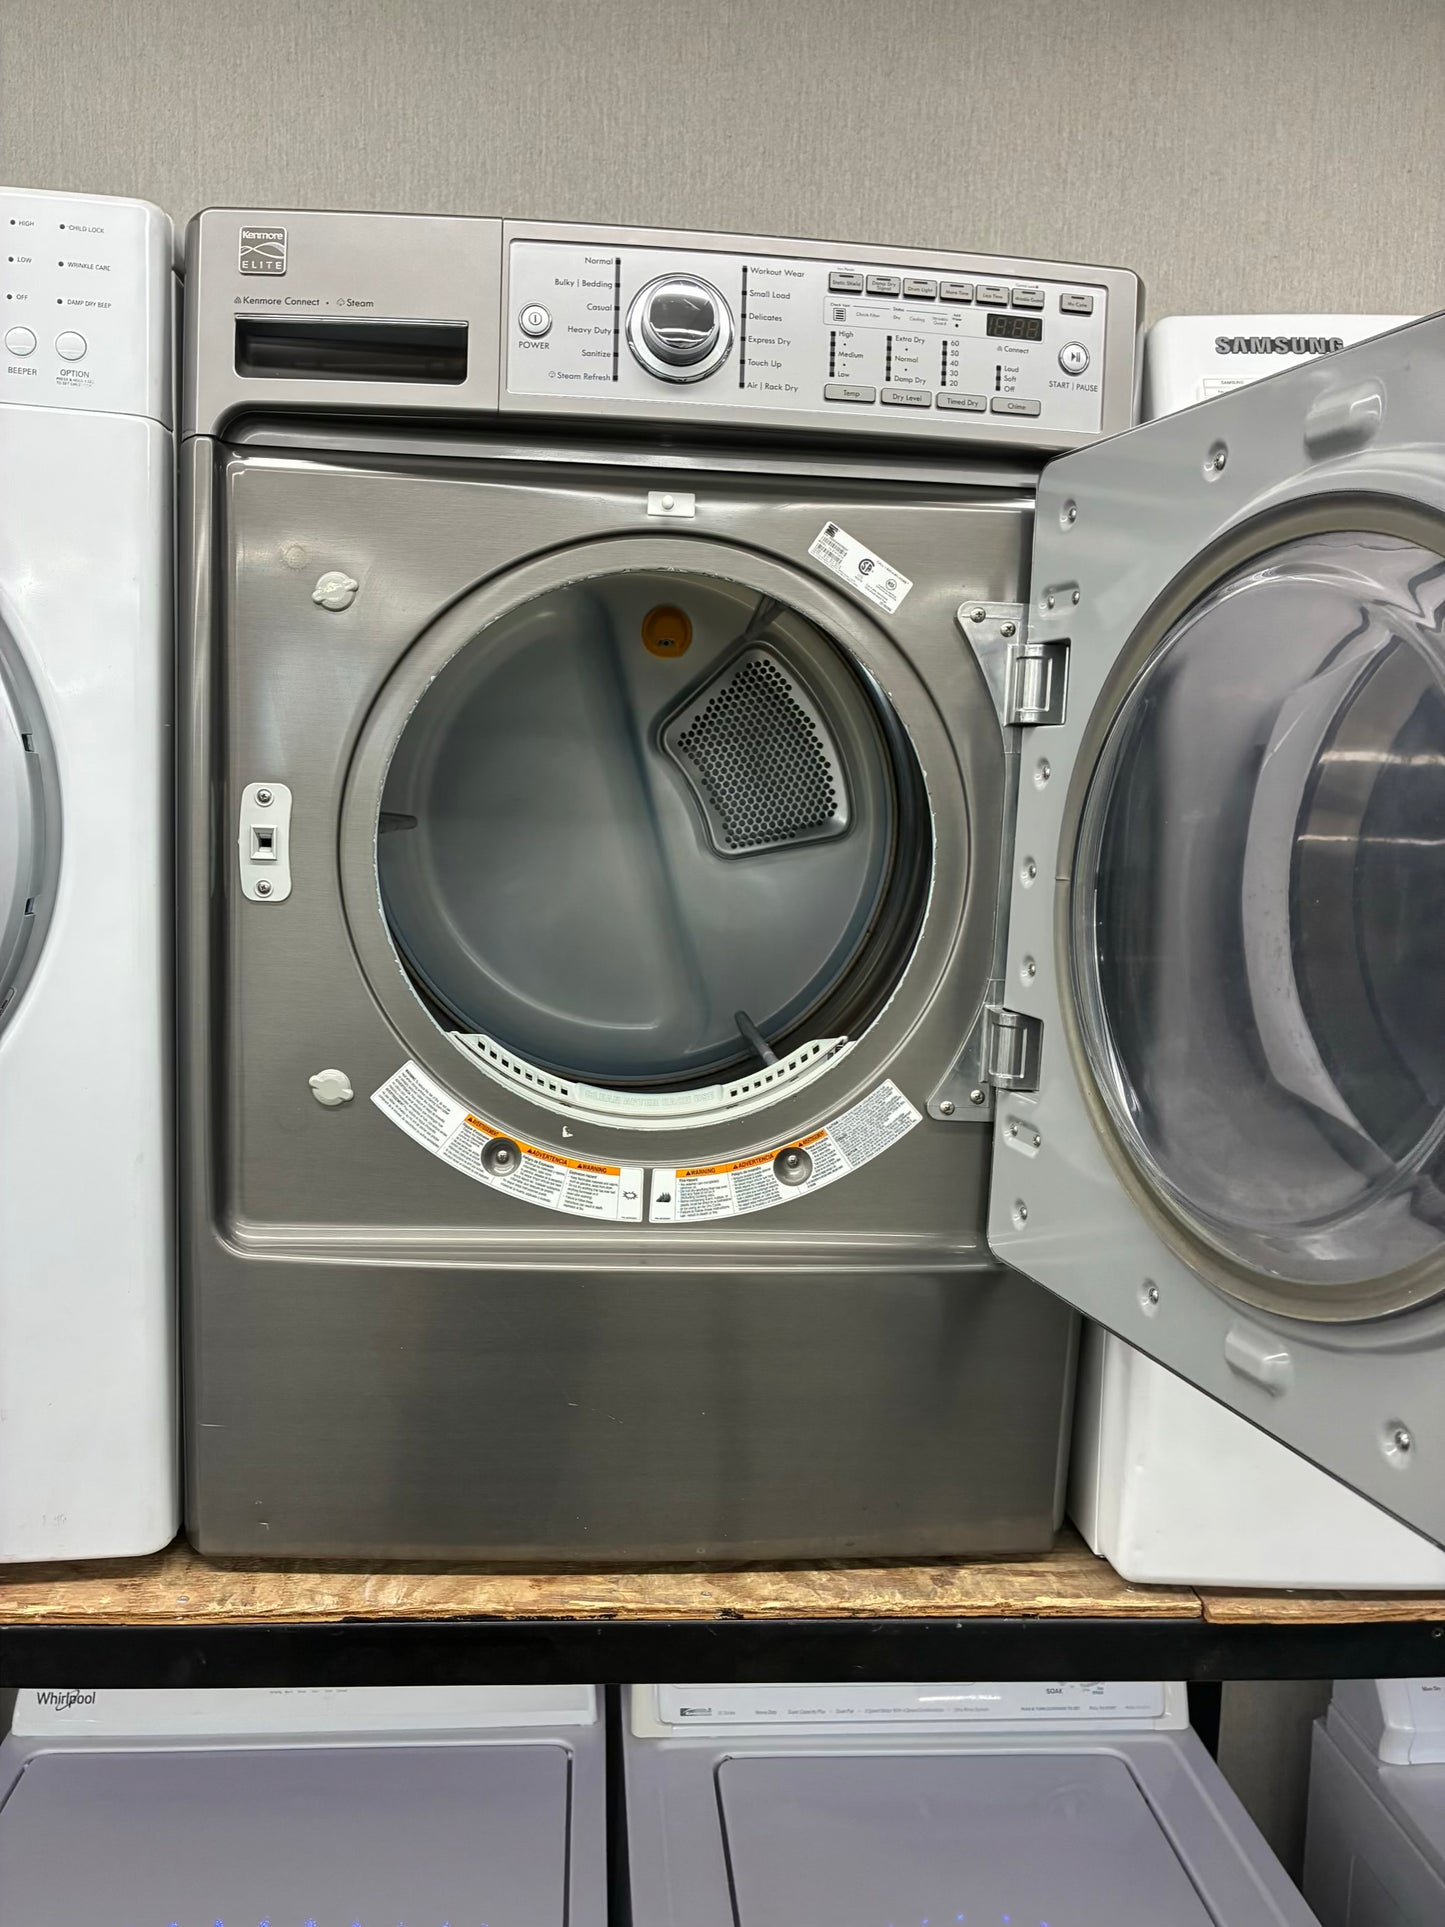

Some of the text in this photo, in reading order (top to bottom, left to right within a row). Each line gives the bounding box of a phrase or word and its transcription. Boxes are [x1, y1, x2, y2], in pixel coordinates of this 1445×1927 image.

[68, 224, 87, 232] CHILD
[242, 230, 284, 240] Kenmore
[242, 260, 282, 270] ELITE
[584, 257, 613, 265] Normal
[67, 261, 111, 272] WRINKLE CARE
[750, 266, 805, 278] Workout Wear
[555, 278, 575, 288] Bulky
[582, 279, 613, 289] Bedding
[749, 289, 791, 300] Small Load
[243, 296, 320, 306] Kenmore Connect
[346, 298, 374, 308] Steam
[586, 303, 612, 312] Casual
[748, 312, 782, 322] Delicates
[567, 325, 612, 336] Heavy Duty
[838, 330, 854, 339] High
[748, 336, 791, 347] Express Dry
[895, 334, 926, 345] Extra Dry
[518, 341, 550, 350] POWER
[1003, 346, 1029, 354] Connect
[1215, 336, 1345, 355] SAMSUNG
[581, 349, 612, 358] Sanitize
[838, 351, 864, 359] Medium
[747, 358, 782, 368] Touch Up
[894, 355, 919, 363] Normal
[7, 366, 37, 376] BEEPER
[59, 368, 90, 378] OPTION
[1004, 365, 1020, 373] Loud
[557, 372, 611, 381] Steam Refresh
[894, 375, 927, 385] Damp Dry
[1003, 375, 1017, 383] Soft
[747, 381, 758, 389] Air
[764, 383, 783, 391] Rack
[784, 384, 799, 393] Dry
[1004, 385, 1016, 393] Off
[1048, 380, 1070, 389] START
[1076, 383, 1099, 393] PAUSE
[843, 389, 861, 398] Temp
[892, 393, 923, 402] Dry Level
[947, 397, 979, 408] Timed Dry
[1007, 403, 1027, 411] Chime
[531, 1149, 568, 1166] ADVERTENCIA
[739, 1153, 775, 1169] ADVERTENCIA
[581, 1164, 607, 1174] WARNING
[690, 1167, 716, 1175] WARNING
[1046, 1687, 1064, 1695] SOAK
[37, 1690, 97, 1712] Whirlpool
